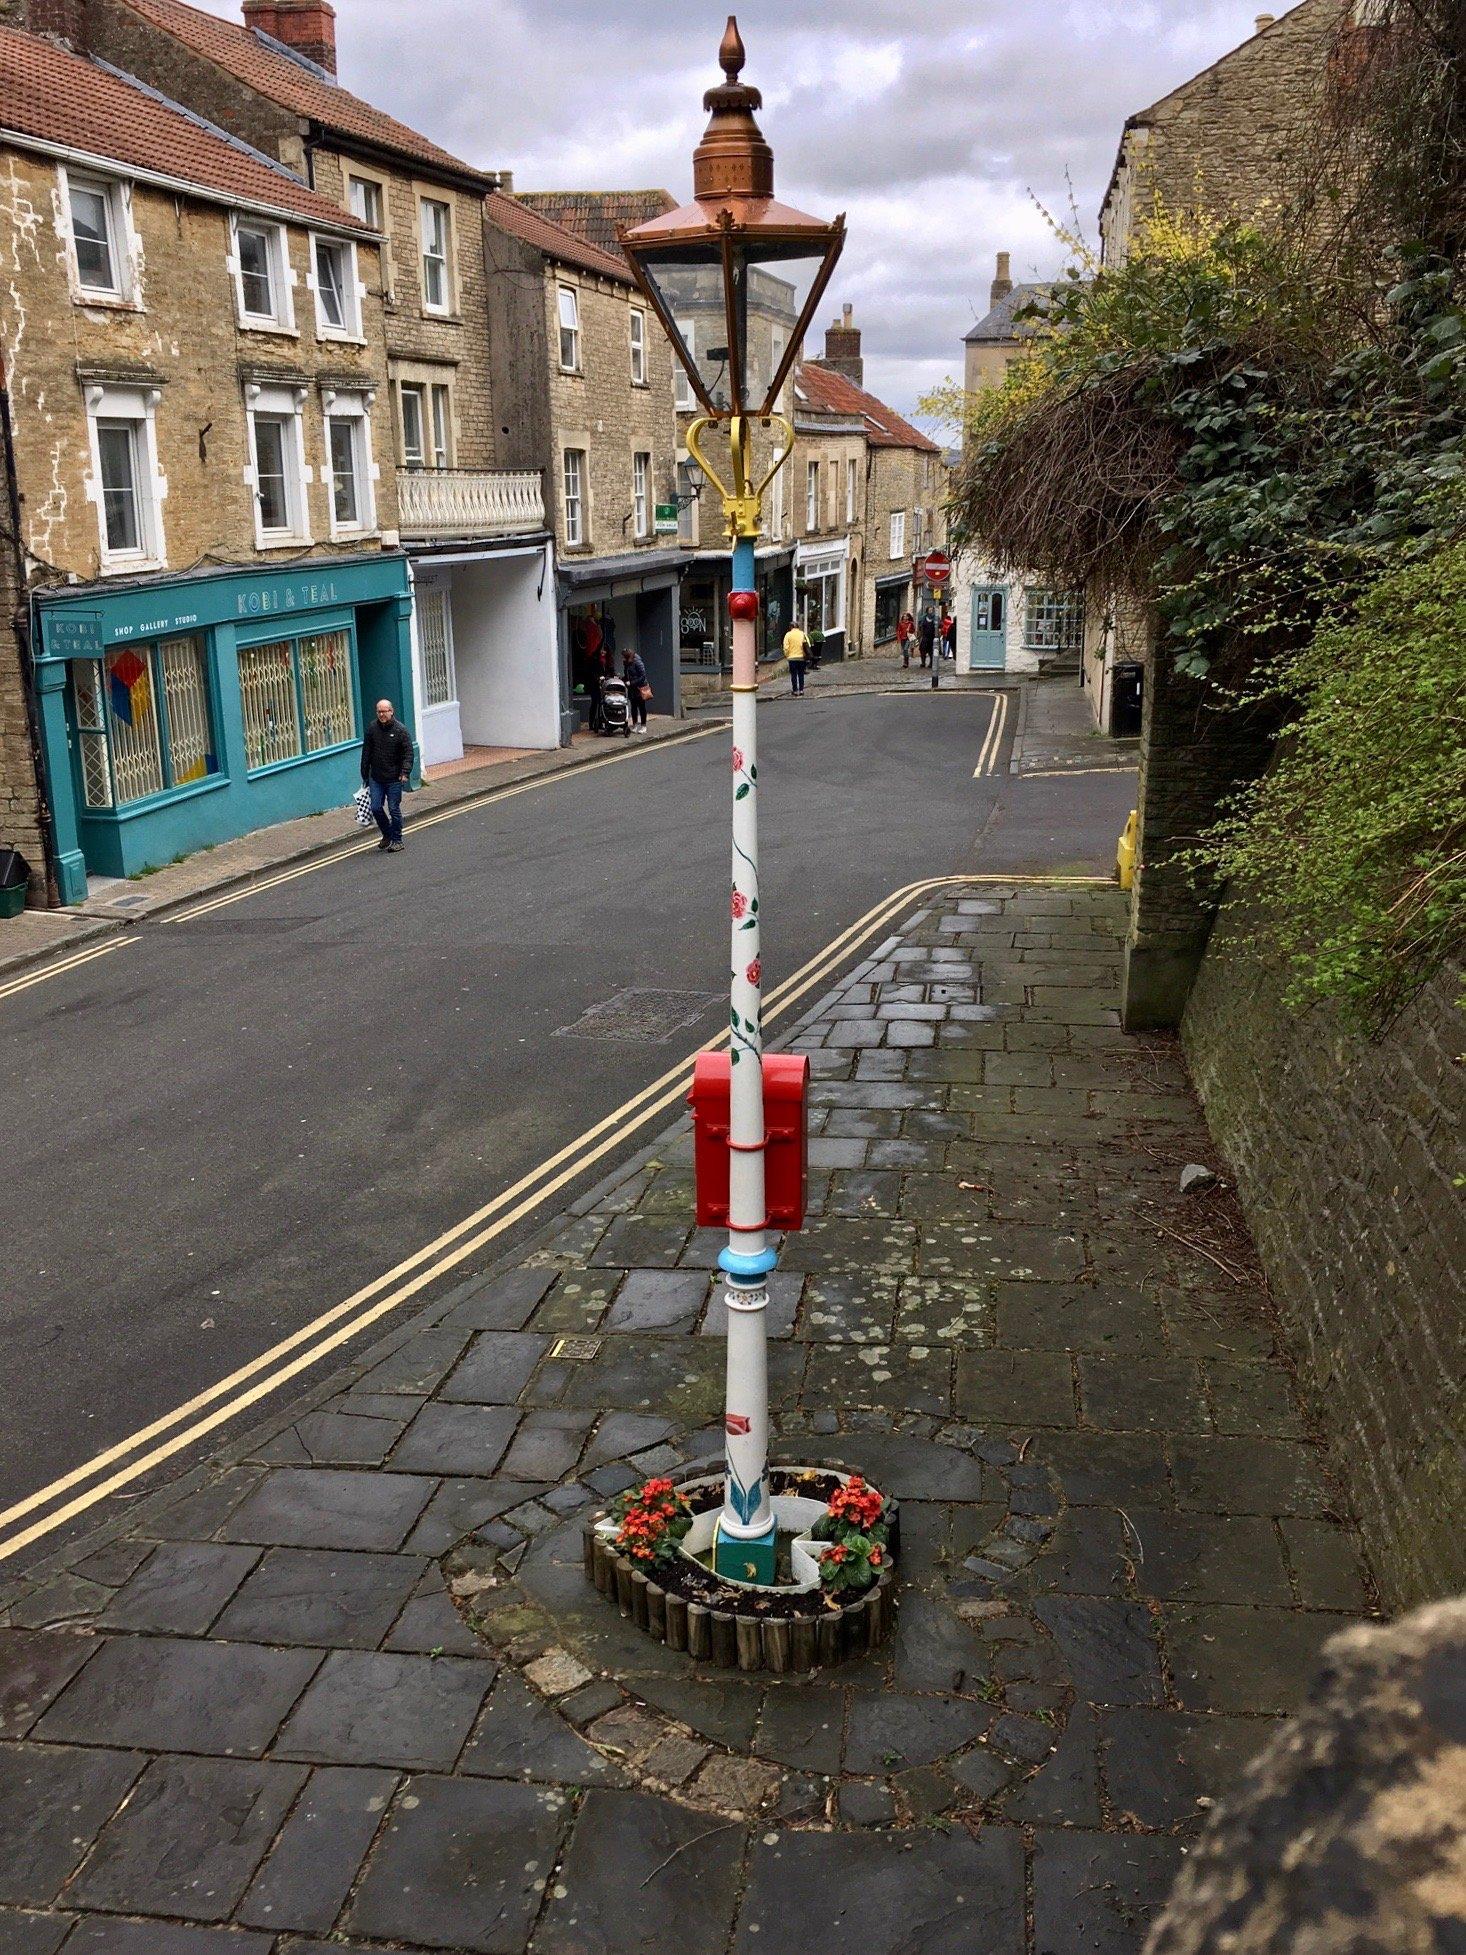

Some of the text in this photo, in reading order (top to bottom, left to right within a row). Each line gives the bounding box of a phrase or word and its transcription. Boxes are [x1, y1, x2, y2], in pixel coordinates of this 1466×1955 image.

[237, 582, 338, 614] KOBI & TEAL
[56, 623, 95, 634] KOBI
[114, 613, 198, 637] SHOP GALLERY STUDIO
[63, 638, 103, 650] TEAL
